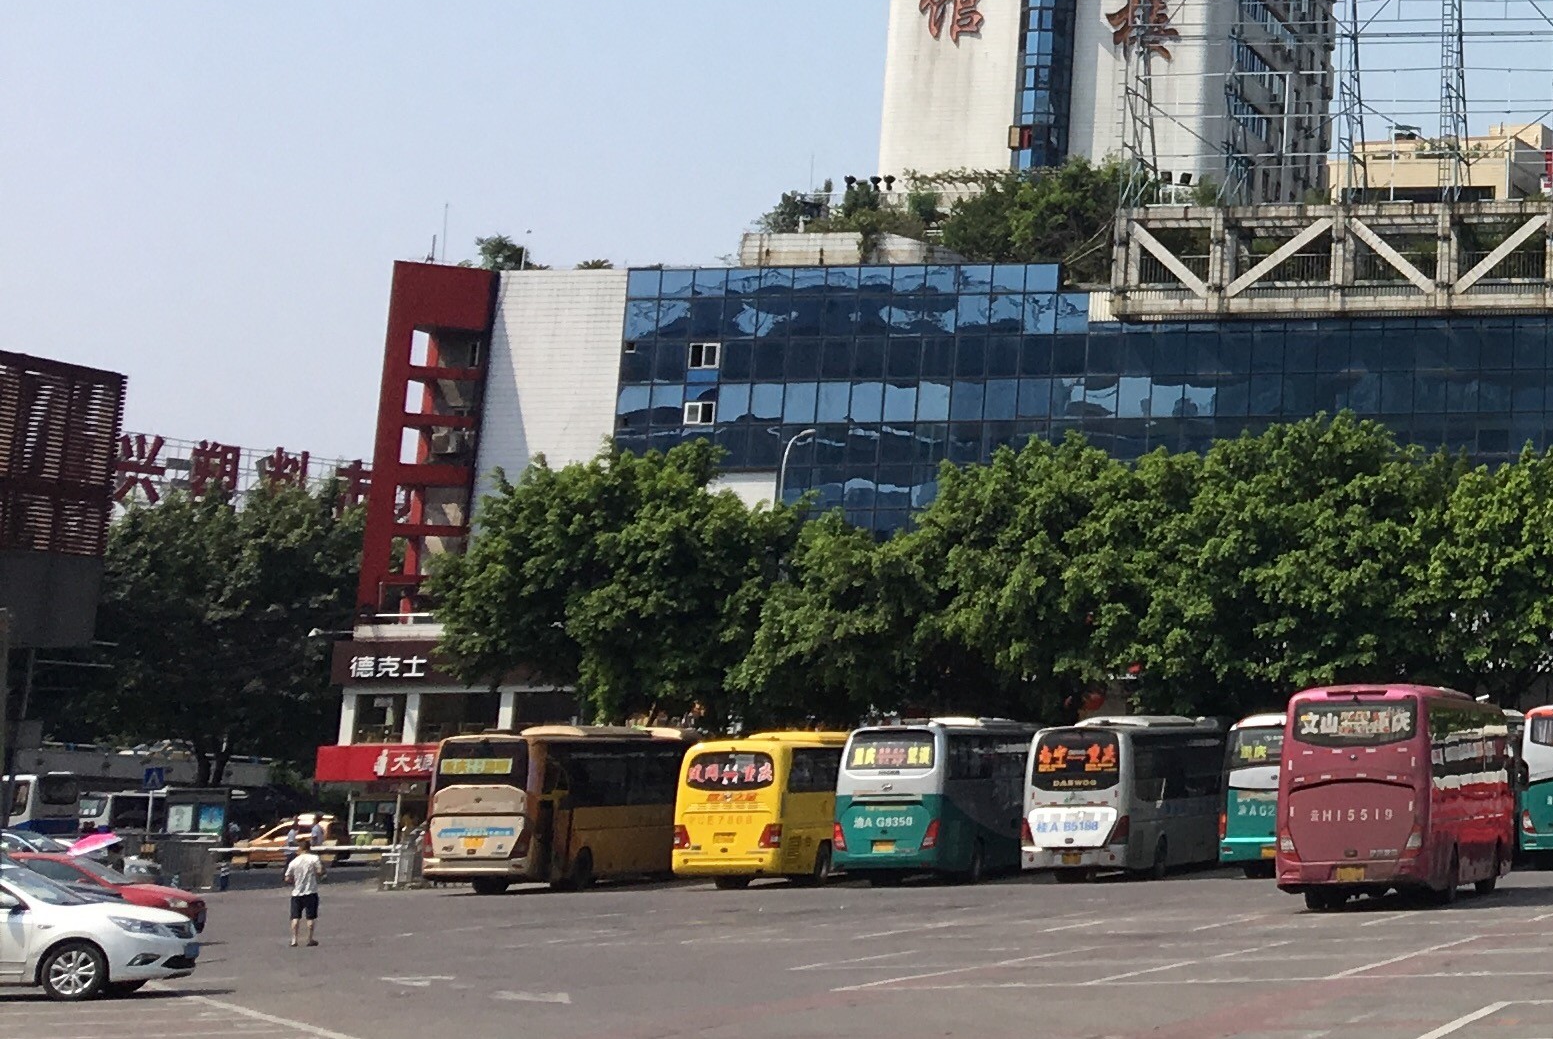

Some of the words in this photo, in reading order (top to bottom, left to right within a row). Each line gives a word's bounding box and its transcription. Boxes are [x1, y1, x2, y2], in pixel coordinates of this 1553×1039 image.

[349, 654, 428, 678] 德克士
[1300, 711, 1339, 735] 文山
